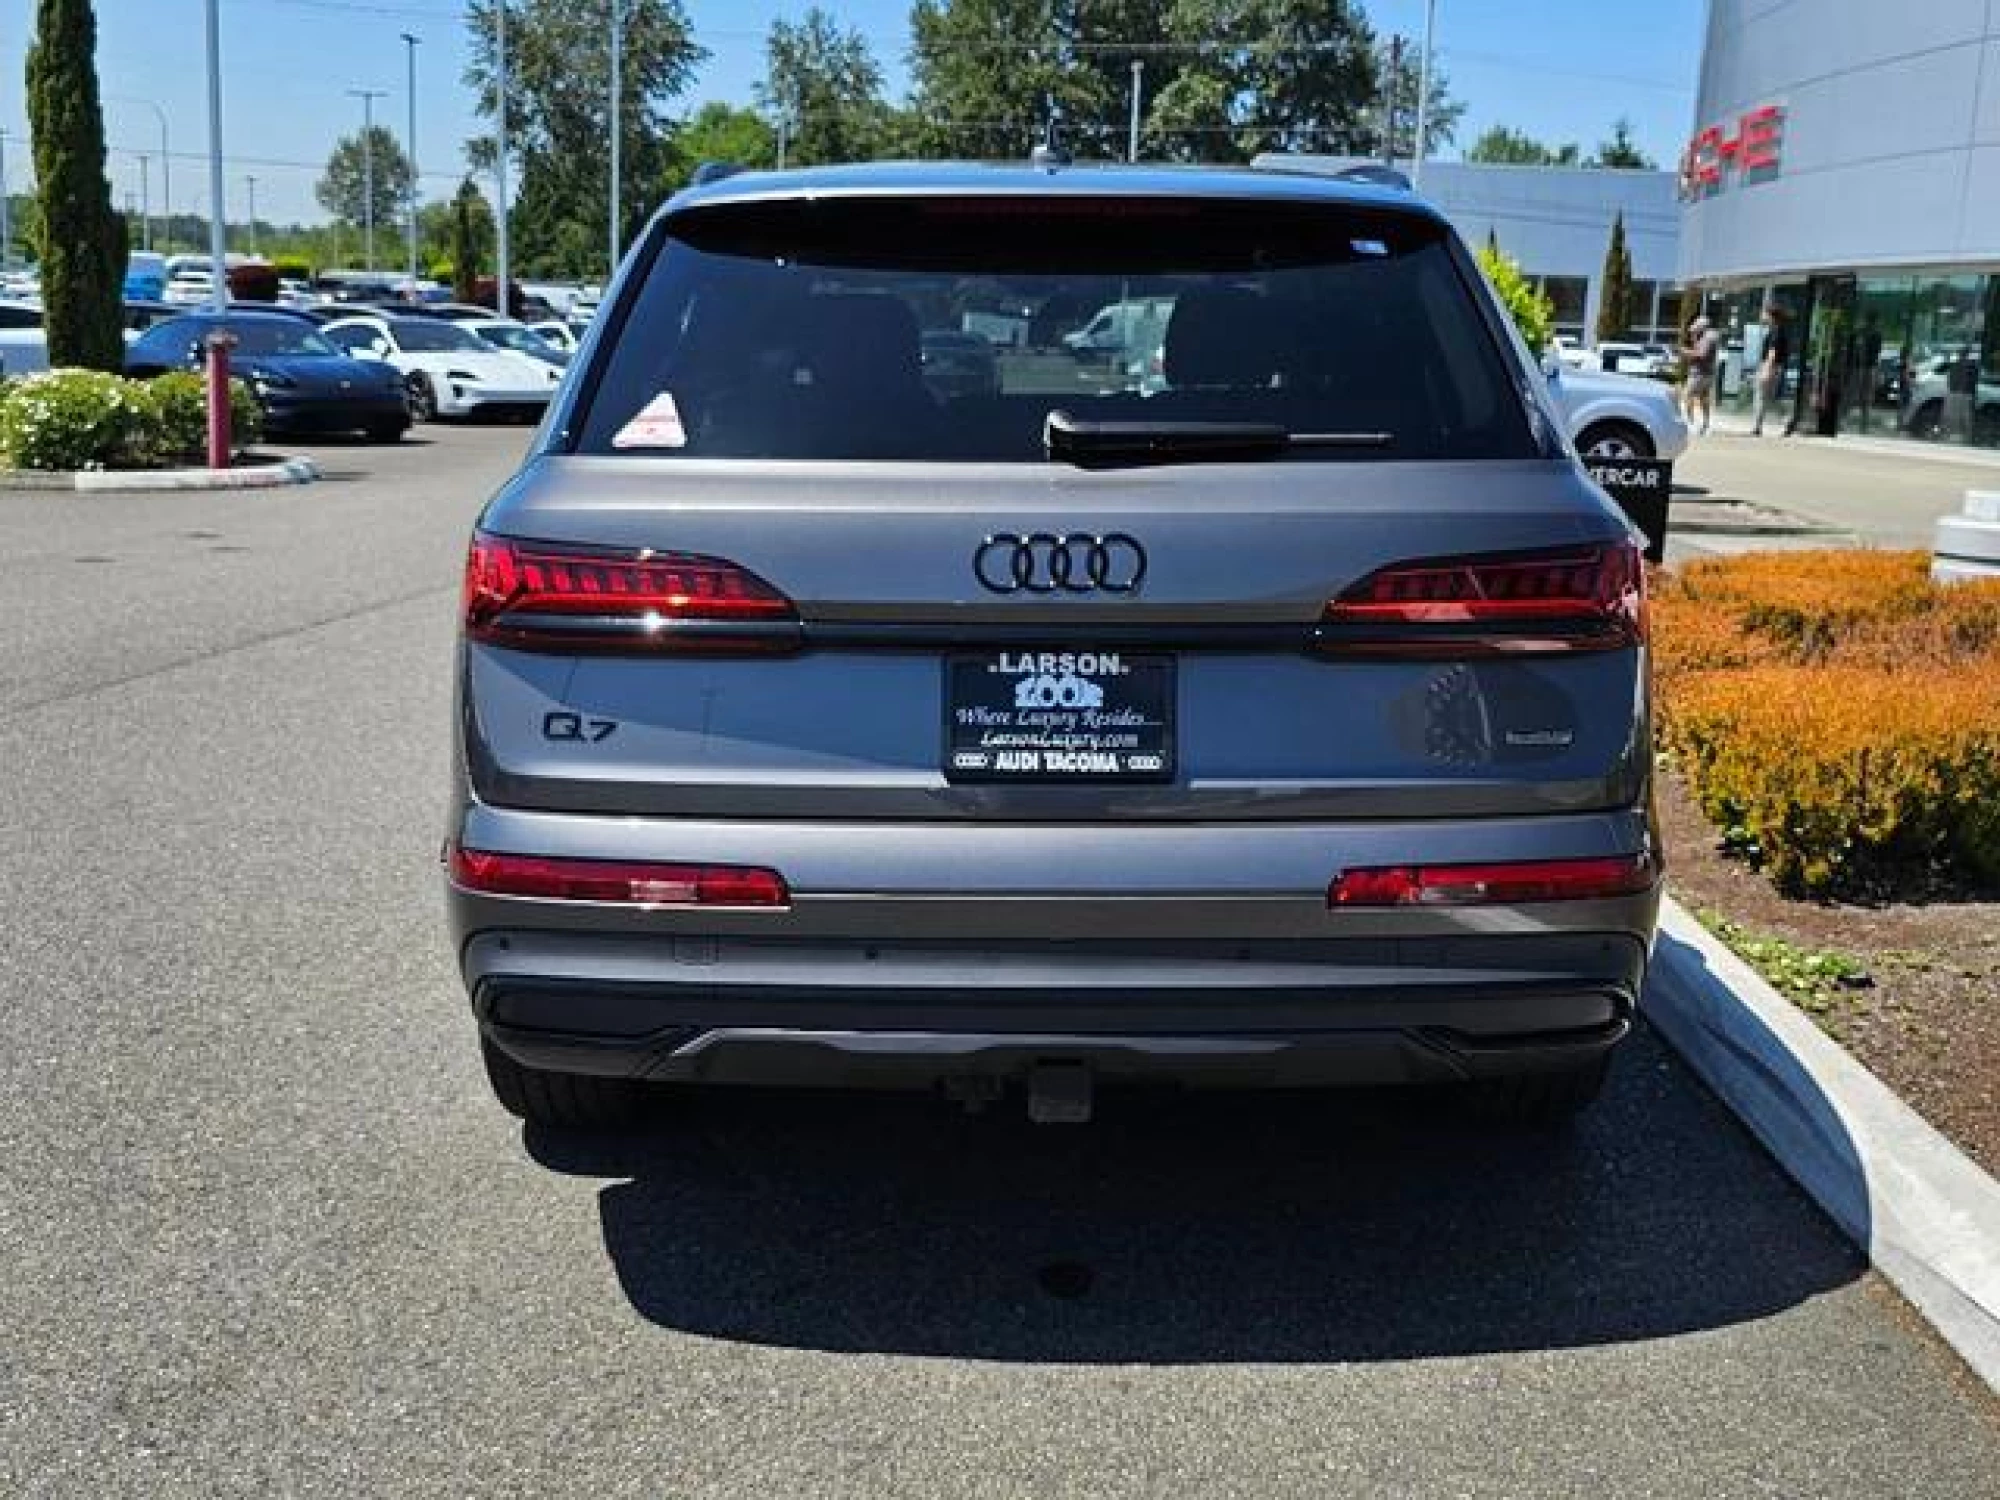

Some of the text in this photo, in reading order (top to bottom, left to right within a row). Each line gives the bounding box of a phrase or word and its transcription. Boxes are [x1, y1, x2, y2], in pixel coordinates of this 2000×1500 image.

[543, 712, 617, 743] Q7
[996, 752, 1120, 772] AUDI TACOMA
